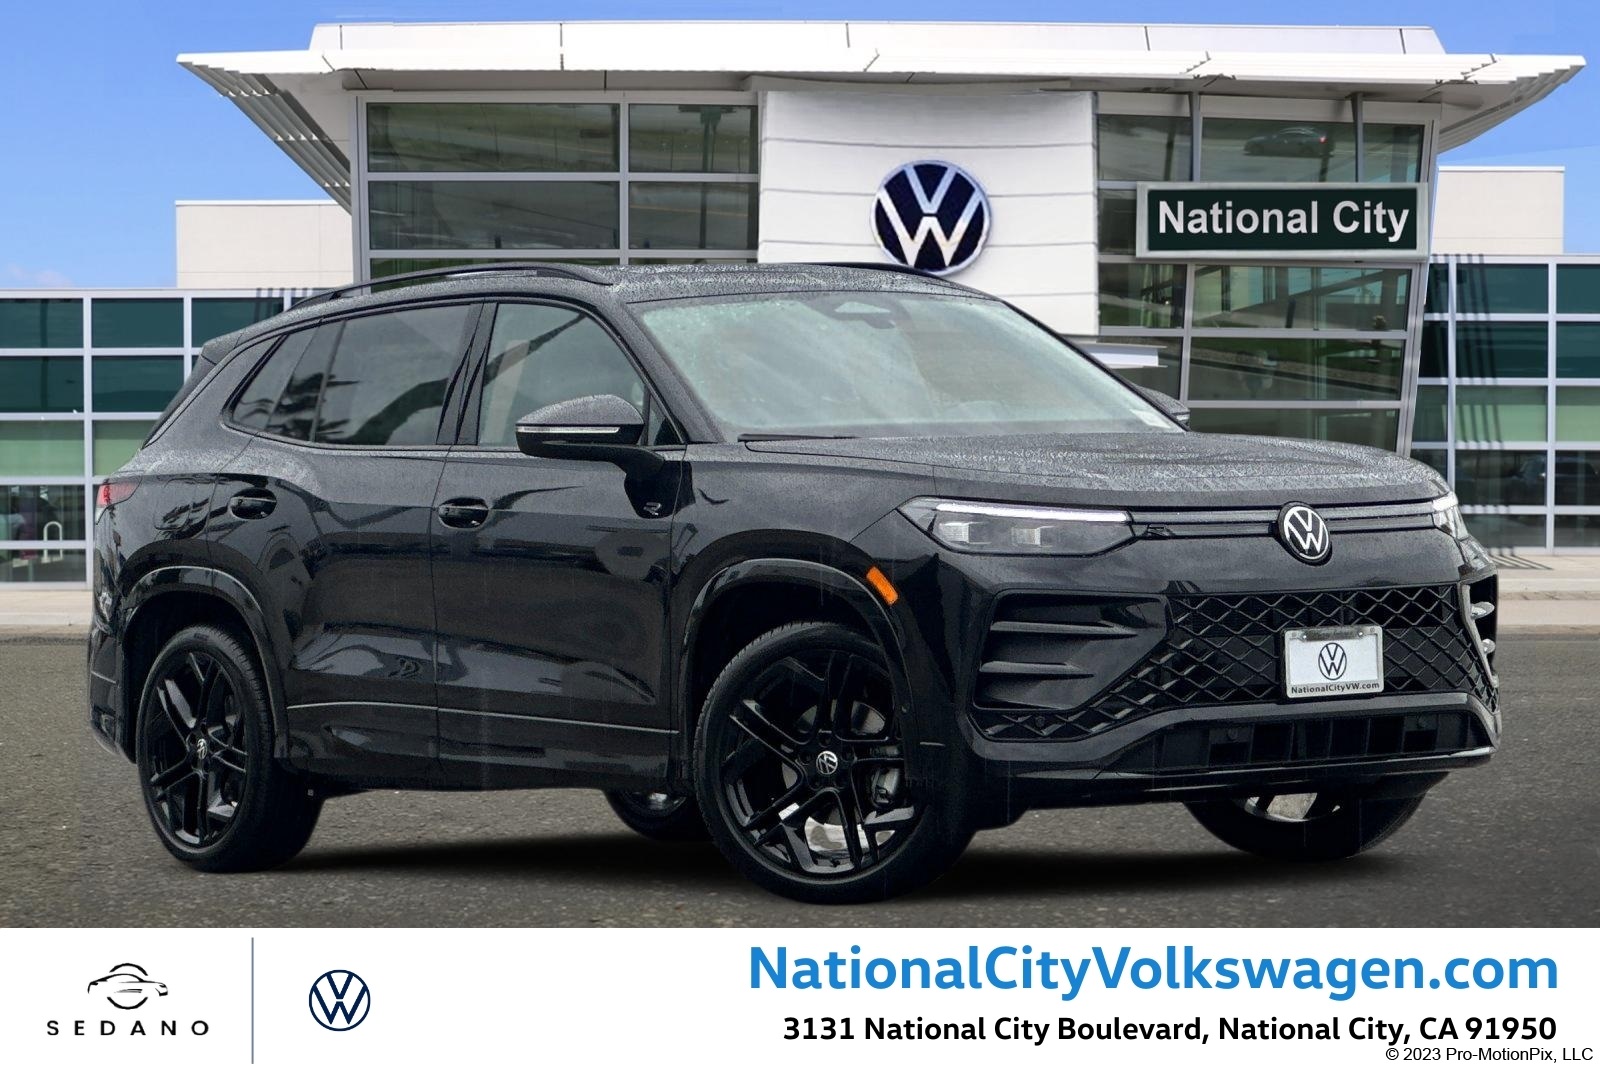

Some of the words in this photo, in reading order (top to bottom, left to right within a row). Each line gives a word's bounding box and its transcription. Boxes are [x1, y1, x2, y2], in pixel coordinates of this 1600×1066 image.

[1159, 200, 1318, 234] National
[1333, 200, 1410, 243] City
[1290, 682, 1381, 694] NationalCityVW.com
